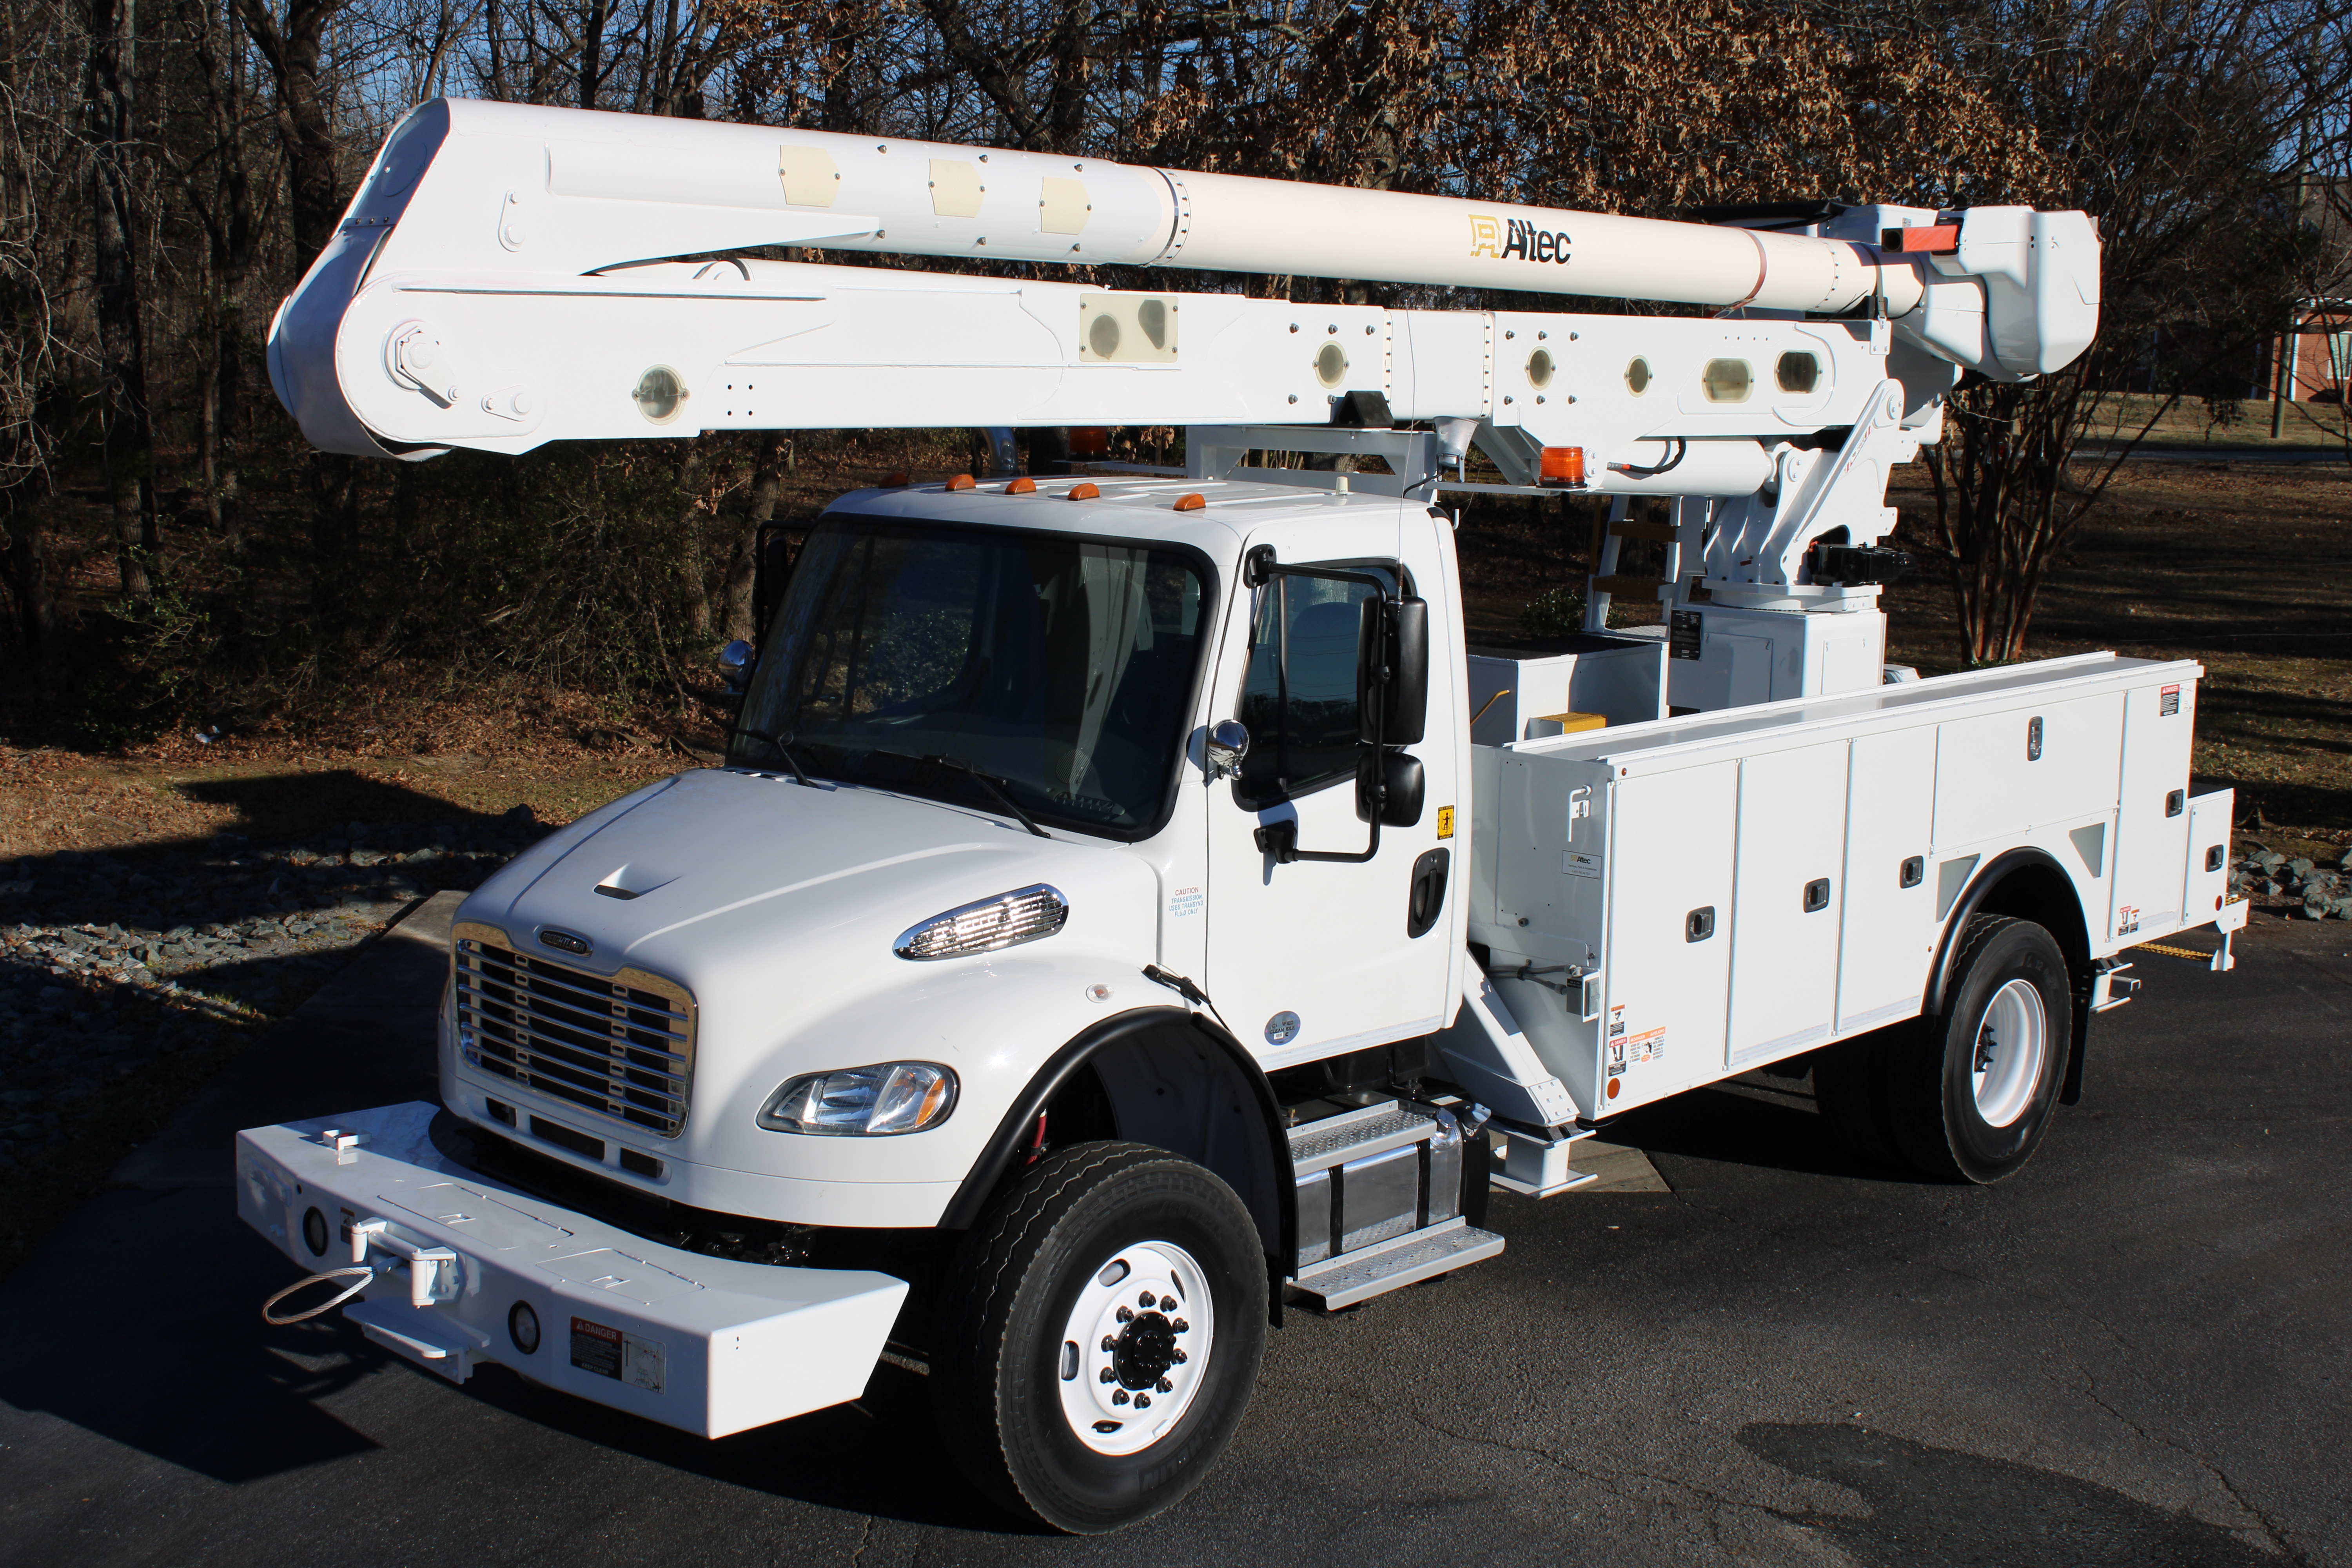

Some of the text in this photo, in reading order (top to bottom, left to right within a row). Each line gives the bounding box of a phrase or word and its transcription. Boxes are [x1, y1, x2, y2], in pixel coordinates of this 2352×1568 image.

[1501, 219, 1572, 264] Altec
[1577, 856, 1591, 864] Altec
[1175, 887, 1199, 896] CAUTION
[1171, 894, 1202, 904] TRANSMISSION
[1182, 900, 1203, 909] TRANSYND
[541, 933, 585, 952] FREIGHTLINER
[585, 1323, 617, 1340] DANGER
[593, 1367, 608, 1375] CLEAR
[1141, 1381, 1234, 1493] MICHELIN
